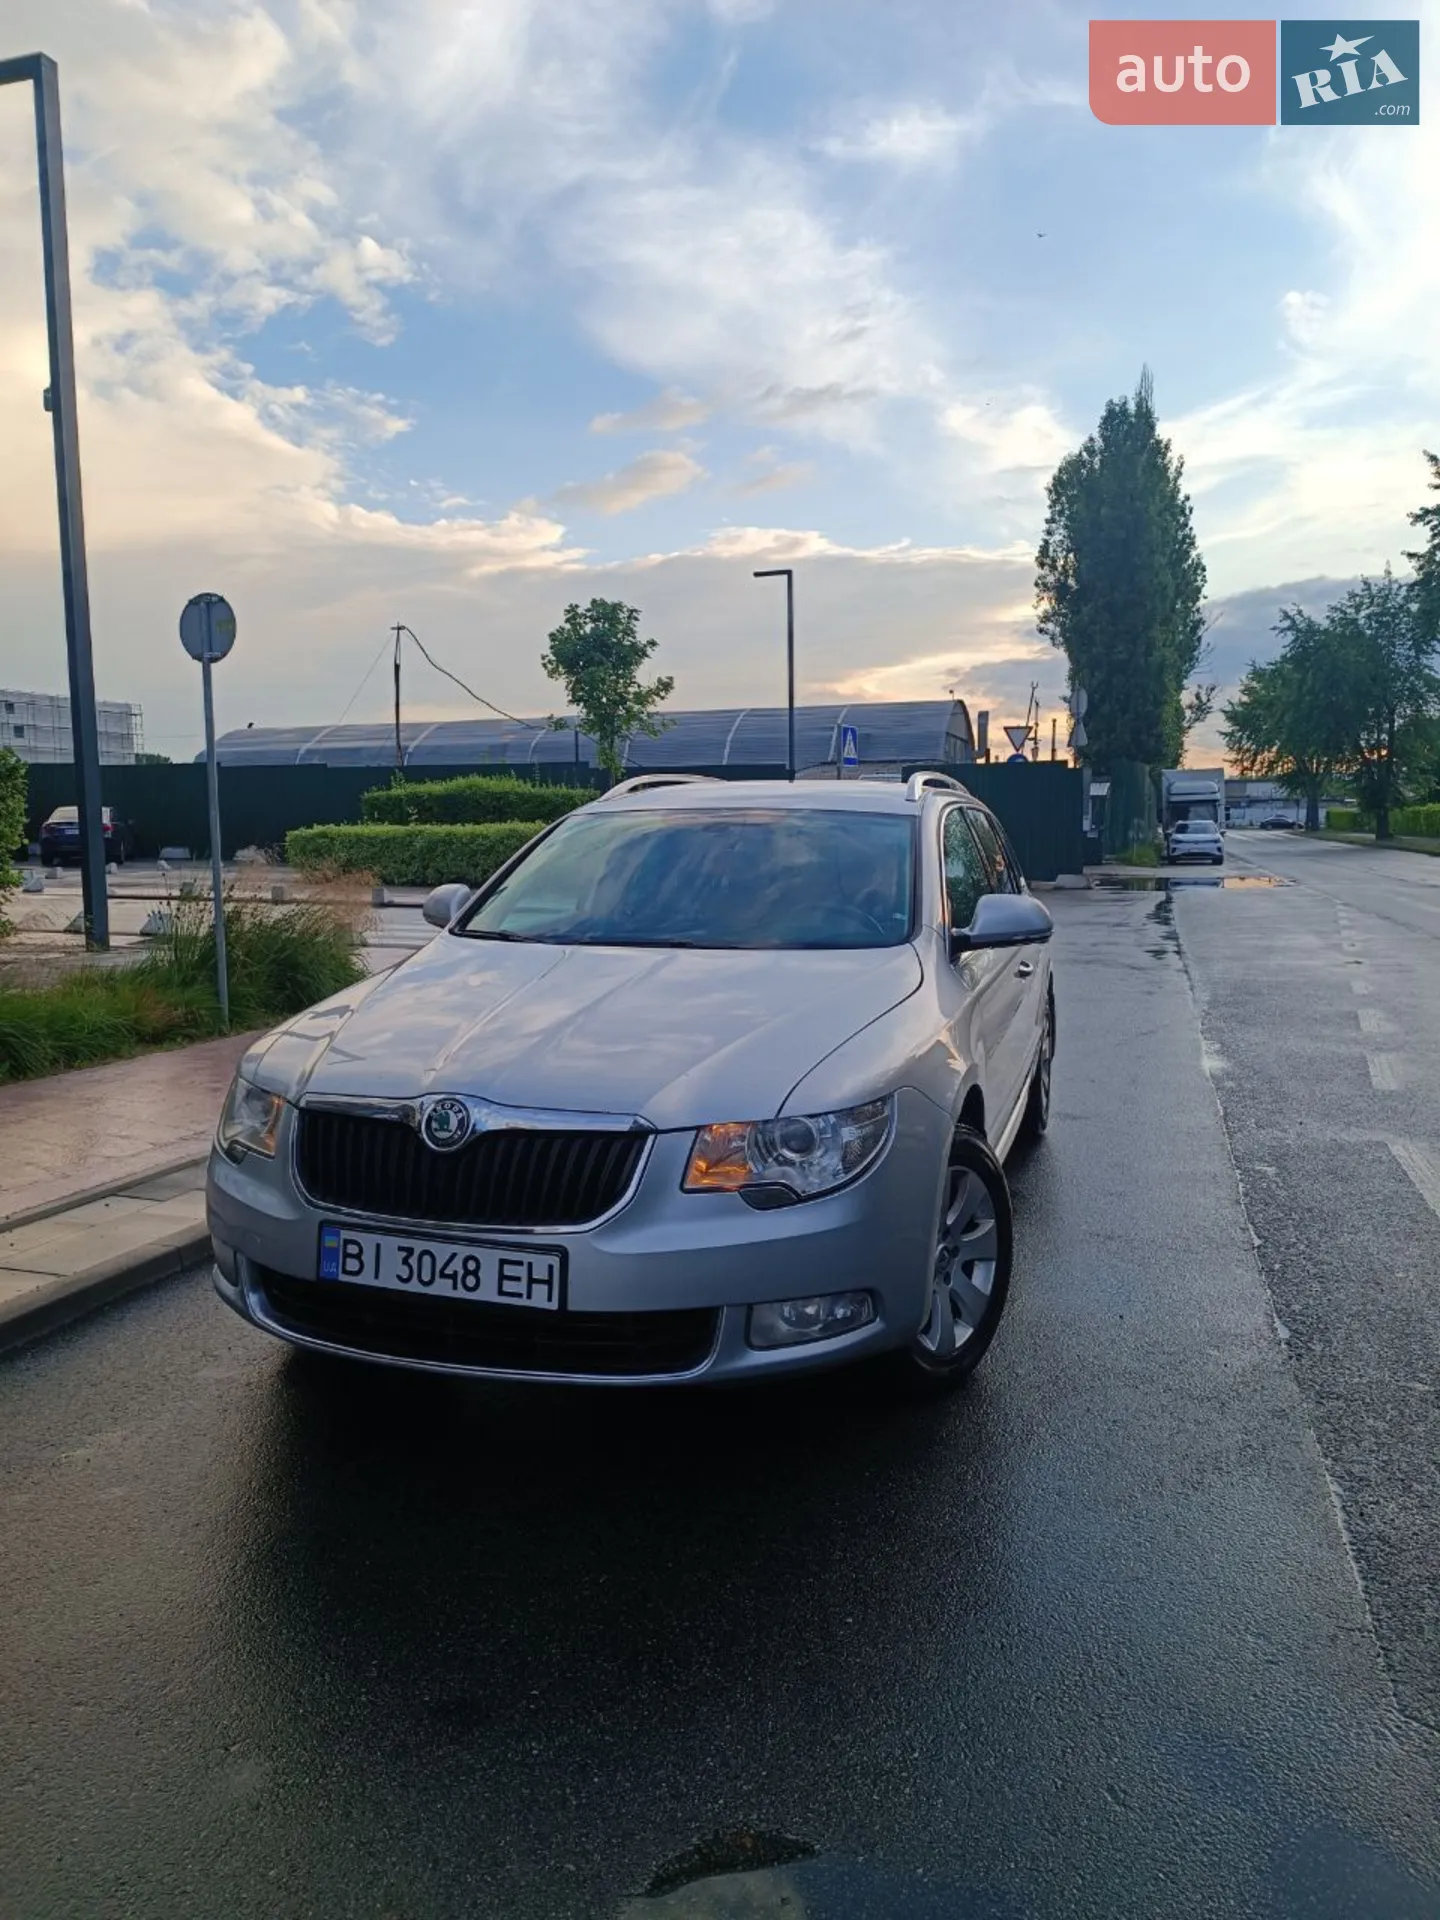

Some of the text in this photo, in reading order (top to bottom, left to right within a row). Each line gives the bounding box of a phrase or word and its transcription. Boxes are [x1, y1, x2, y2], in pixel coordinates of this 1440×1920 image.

[323, 1260, 337, 1273] UA
[341, 1237, 555, 1303] BI 3048 EH
